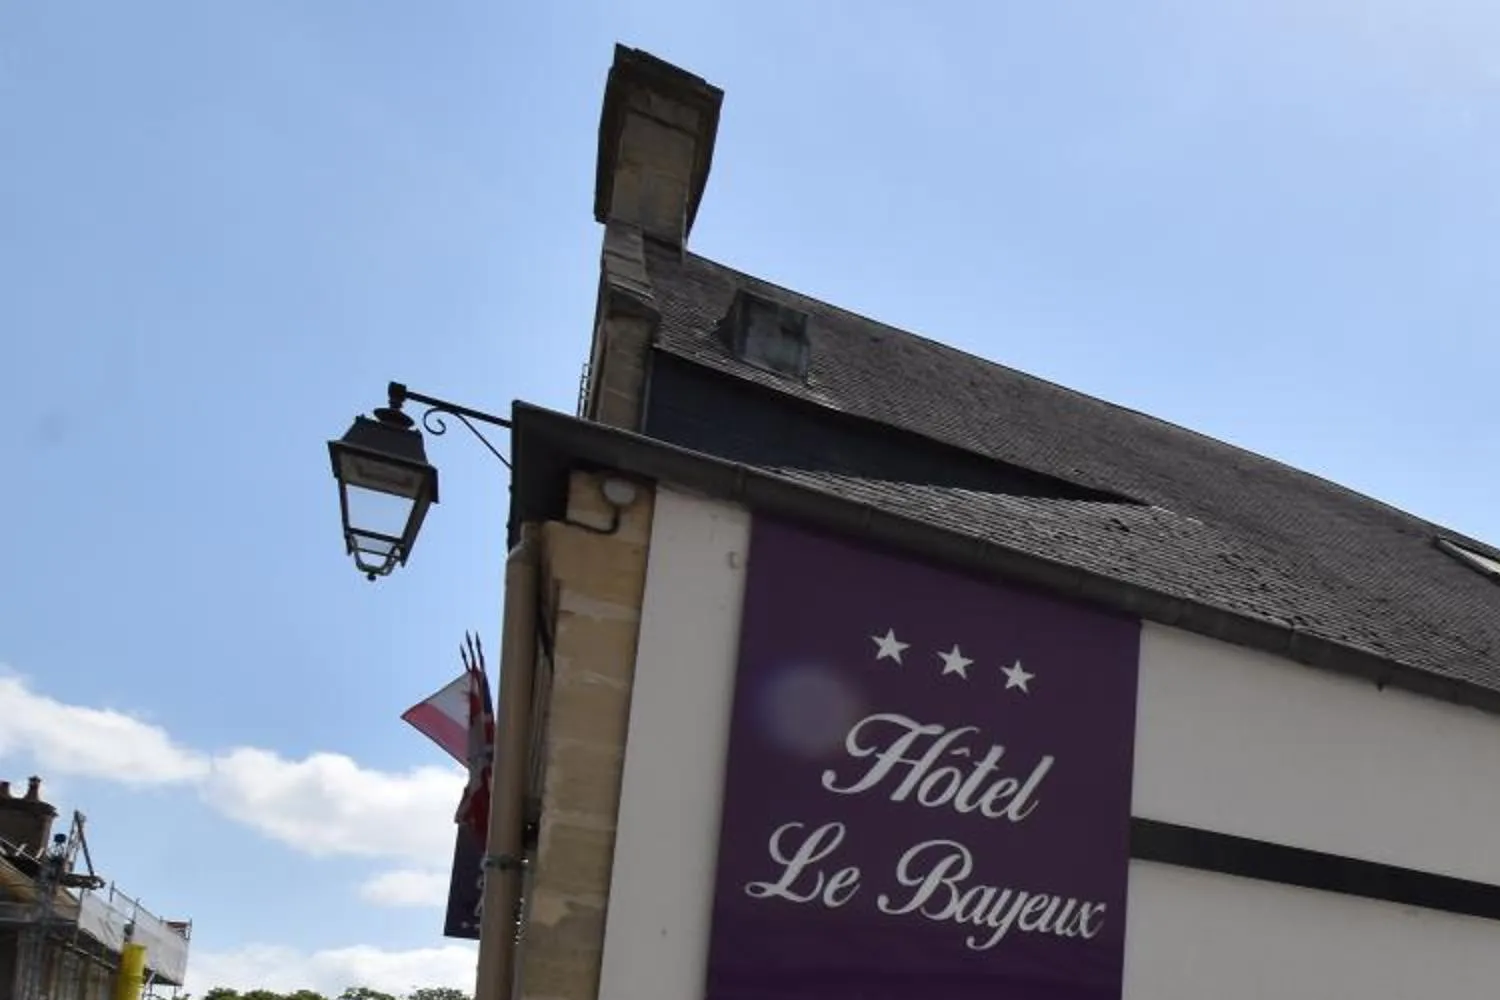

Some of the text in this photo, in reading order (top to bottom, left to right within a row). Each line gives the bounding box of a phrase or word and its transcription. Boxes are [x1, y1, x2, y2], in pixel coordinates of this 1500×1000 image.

[821, 713, 1055, 822] Hôtel
[744, 822, 1106, 950] Le Bayeux
